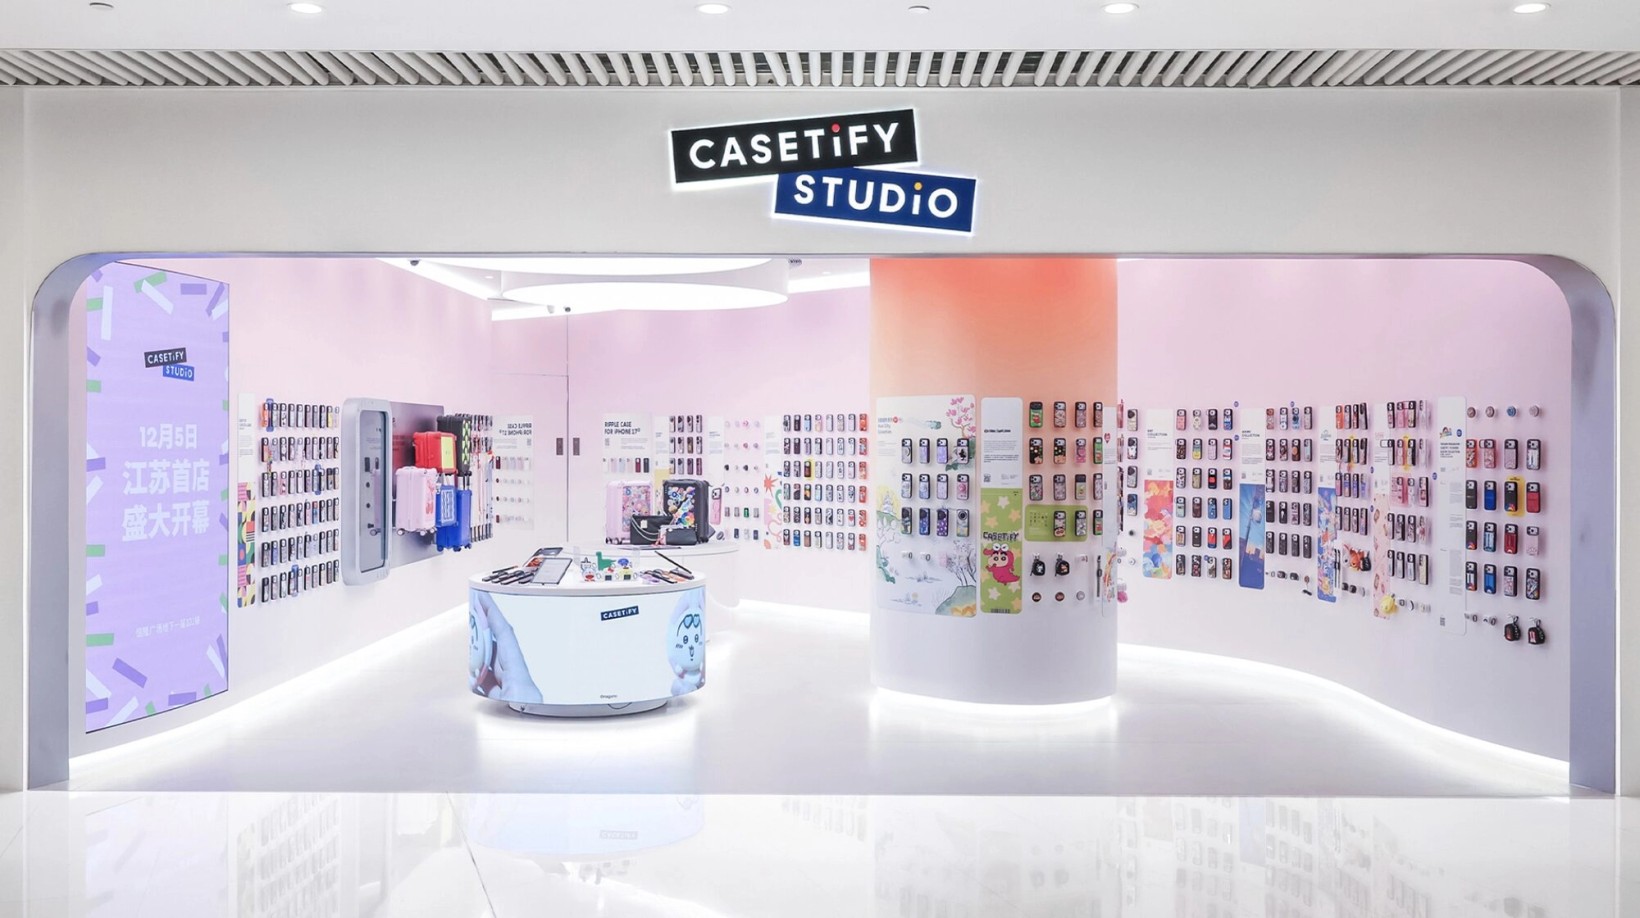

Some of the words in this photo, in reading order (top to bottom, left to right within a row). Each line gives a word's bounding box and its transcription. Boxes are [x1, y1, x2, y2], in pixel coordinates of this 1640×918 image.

[689, 122, 898, 169] CASETiFY
[793, 174, 958, 218] STUDiO
[139, 423, 197, 449] 12月5日
[122, 458, 210, 495] 江苏首店
[122, 499, 210, 542] 盛大开幕
